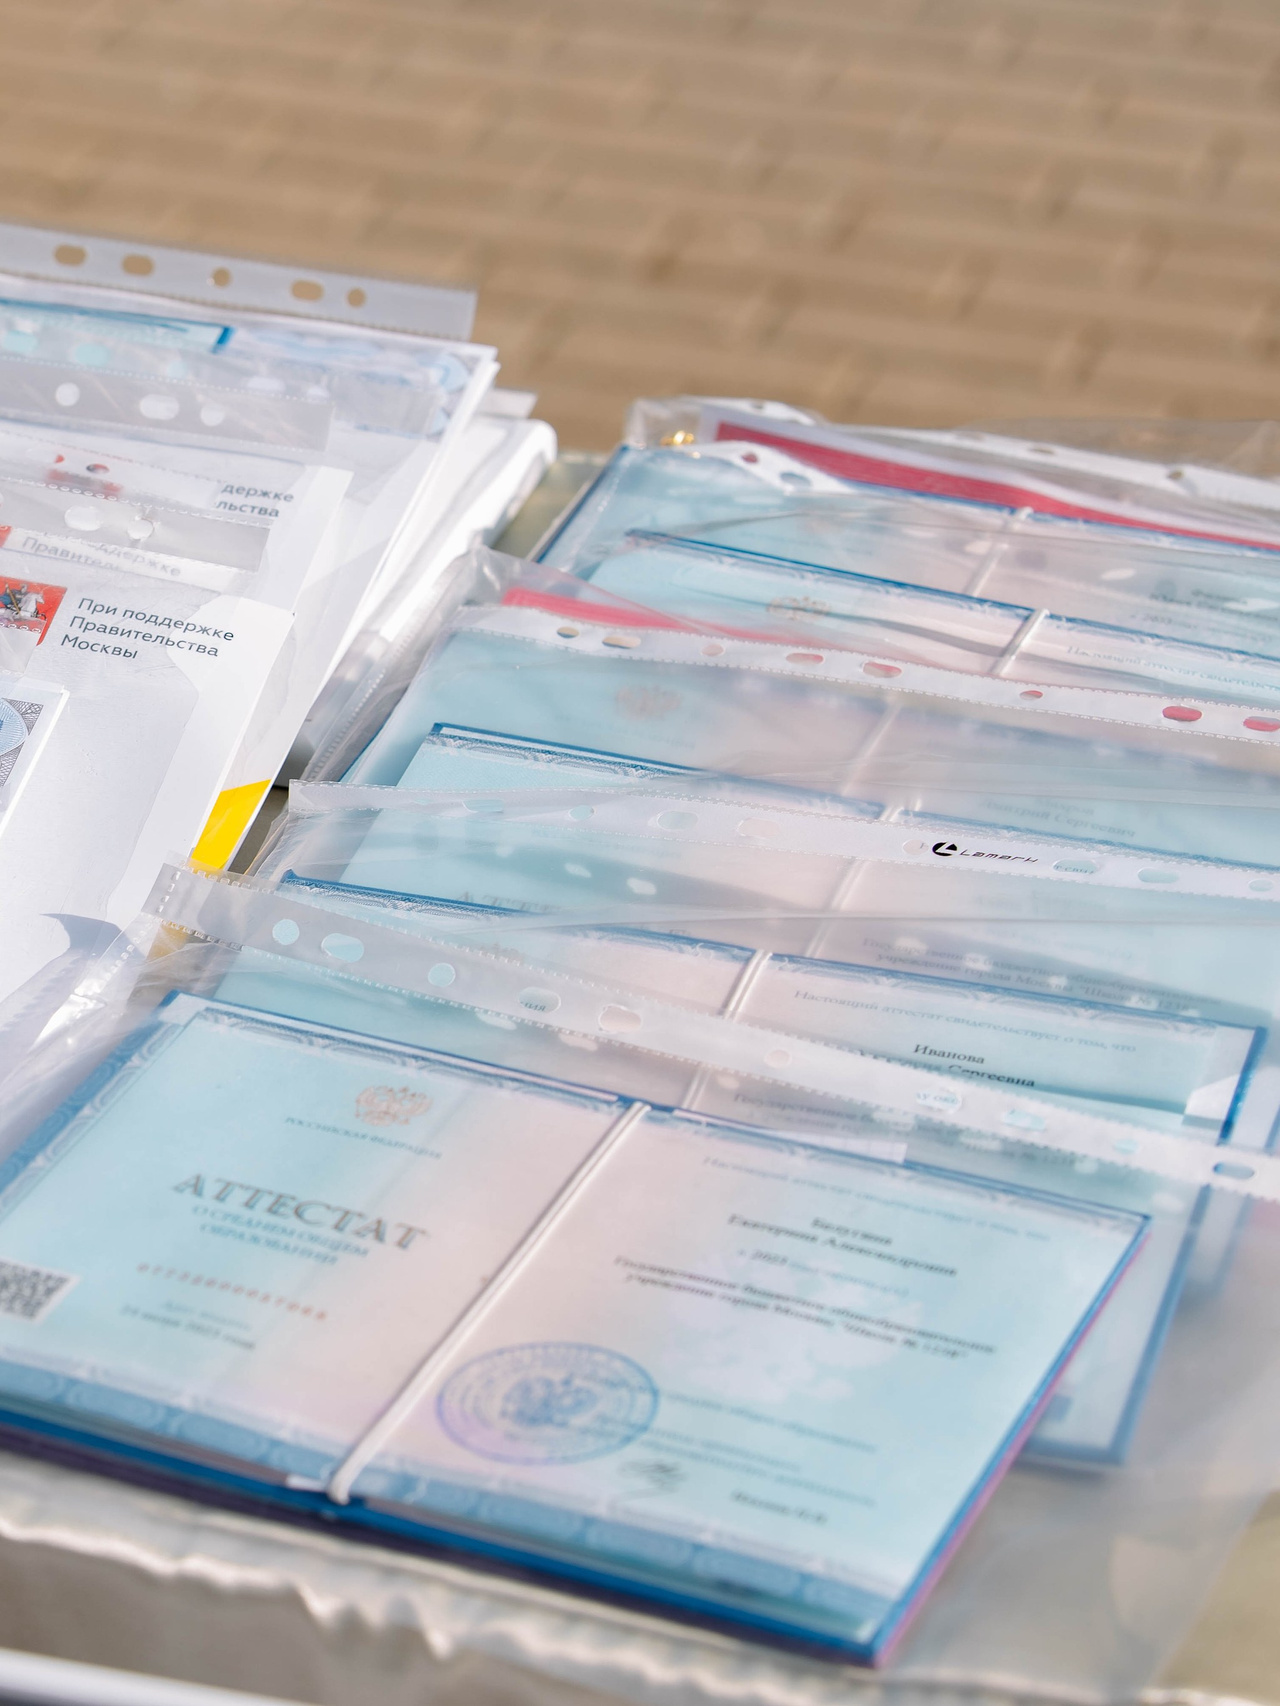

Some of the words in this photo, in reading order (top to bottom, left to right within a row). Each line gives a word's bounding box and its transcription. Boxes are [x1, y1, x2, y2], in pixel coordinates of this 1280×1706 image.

[221, 484, 294, 502] держке
[78, 597, 118, 615] При
[122, 609, 234, 641] поддержке
[60, 633, 138, 659] Москвы
[69, 615, 219, 657] Правительства
[794, 990, 878, 1011] Настоящий
[882, 1004, 944, 1022] аттестат
[913, 1043, 985, 1066] Иванова
[173, 1172, 430, 1251] АТТЕСТАТ
